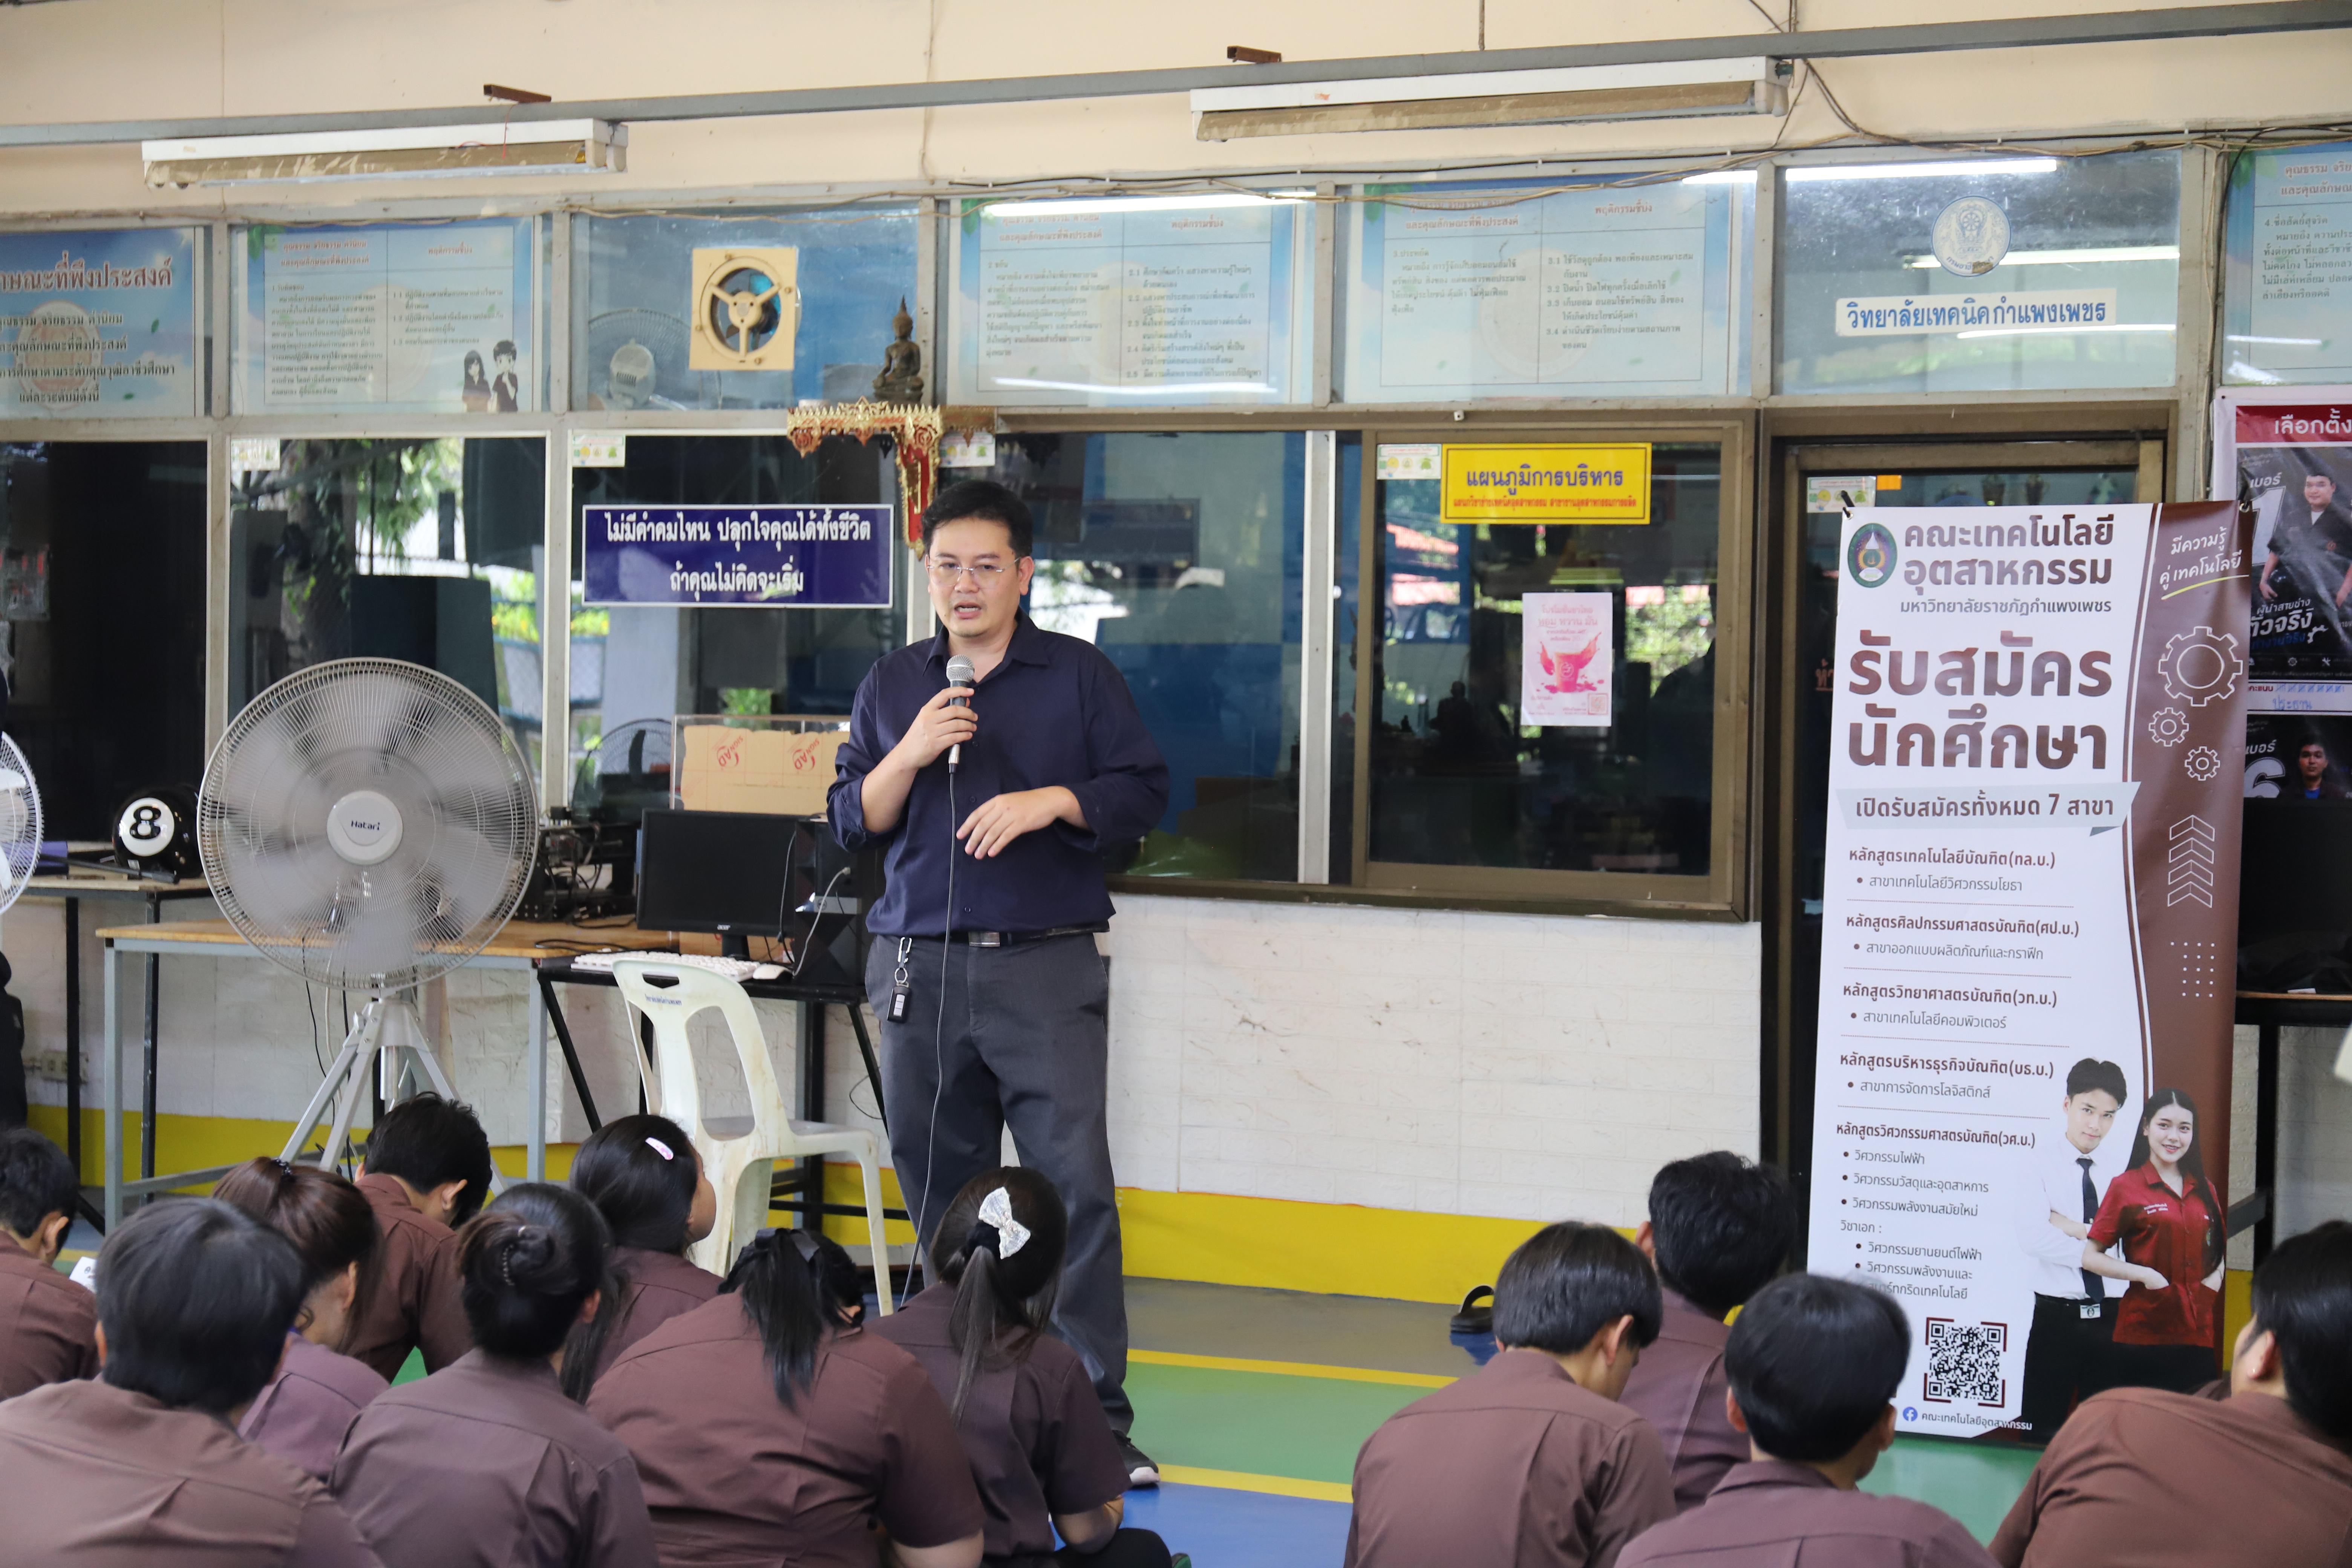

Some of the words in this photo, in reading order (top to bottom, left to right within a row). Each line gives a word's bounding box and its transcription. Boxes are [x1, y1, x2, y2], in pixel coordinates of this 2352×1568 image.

[2285, 164, 2328, 178] คุณธรรม
[1847, 296, 2106, 328] วิทยาลัยเทคนิคกำแพงเพชร
[1467, 463, 1623, 495] แผนภูมิการบริหาร
[1904, 514, 2115, 547] คณะเทคโนโลยี
[2171, 526, 2227, 555] มีความรู้
[1904, 558, 2112, 596] อุตสาหกรรม
[1901, 597, 2112, 617] มหาวิทยาลัยราชภัฏกำแพงเพชร
[1849, 629, 2112, 697] รับสมัคร
[1848, 703, 2107, 770] นักศึกษา
[1856, 790, 2040, 817] เปิดรับสมัครทั้งหมด
[2048, 793, 2060, 815] 7
[2067, 796, 2113, 816] สาขา
[130, 805, 162, 840] 8
[351, 820, 380, 831] Hatari
[1869, 874, 2022, 891] สาขาเทคโนโลยีวิศวกรรมโยธา
[1843, 982, 2058, 1008] หลักสูตรวิทยาศาสตรบัณฑิต(วท.บ.)
[1863, 1011, 2007, 1029] สาขาเทคโนโลยีคอมพิวเตอร์
[1840, 1051, 2054, 1079] หลักสูตรบริหารธุรกิจบัณฑิต(บธ.บ.)
[1860, 1080, 1991, 1099] สาขาการจัดการโลจิสติกส์
[1836, 1122, 2036, 1148] หลักสูตรวิศวกรรมศาสตรบัณฑิต(วศ.บ.)
[1854, 1150, 1925, 1165] วิศวกรรมไฟฟ้า
[1853, 1173, 1989, 1193] วิศวกรรมวัสดุและอุตสาหการ
[1852, 1197, 1978, 1217] วิศวกรรมพลังงานสมัยใหม่
[1841, 1220, 1875, 1233] วิชาเอก
[1868, 1242, 1982, 1261] วิศวกรรมยานยนต์ไฟฟ้า
[1867, 1262, 1973, 1280] วิศวกรรมพลังงานและ
[1922, 1413, 2032, 1431] คณะเทคโนโลยีอุตสาหกรรม
